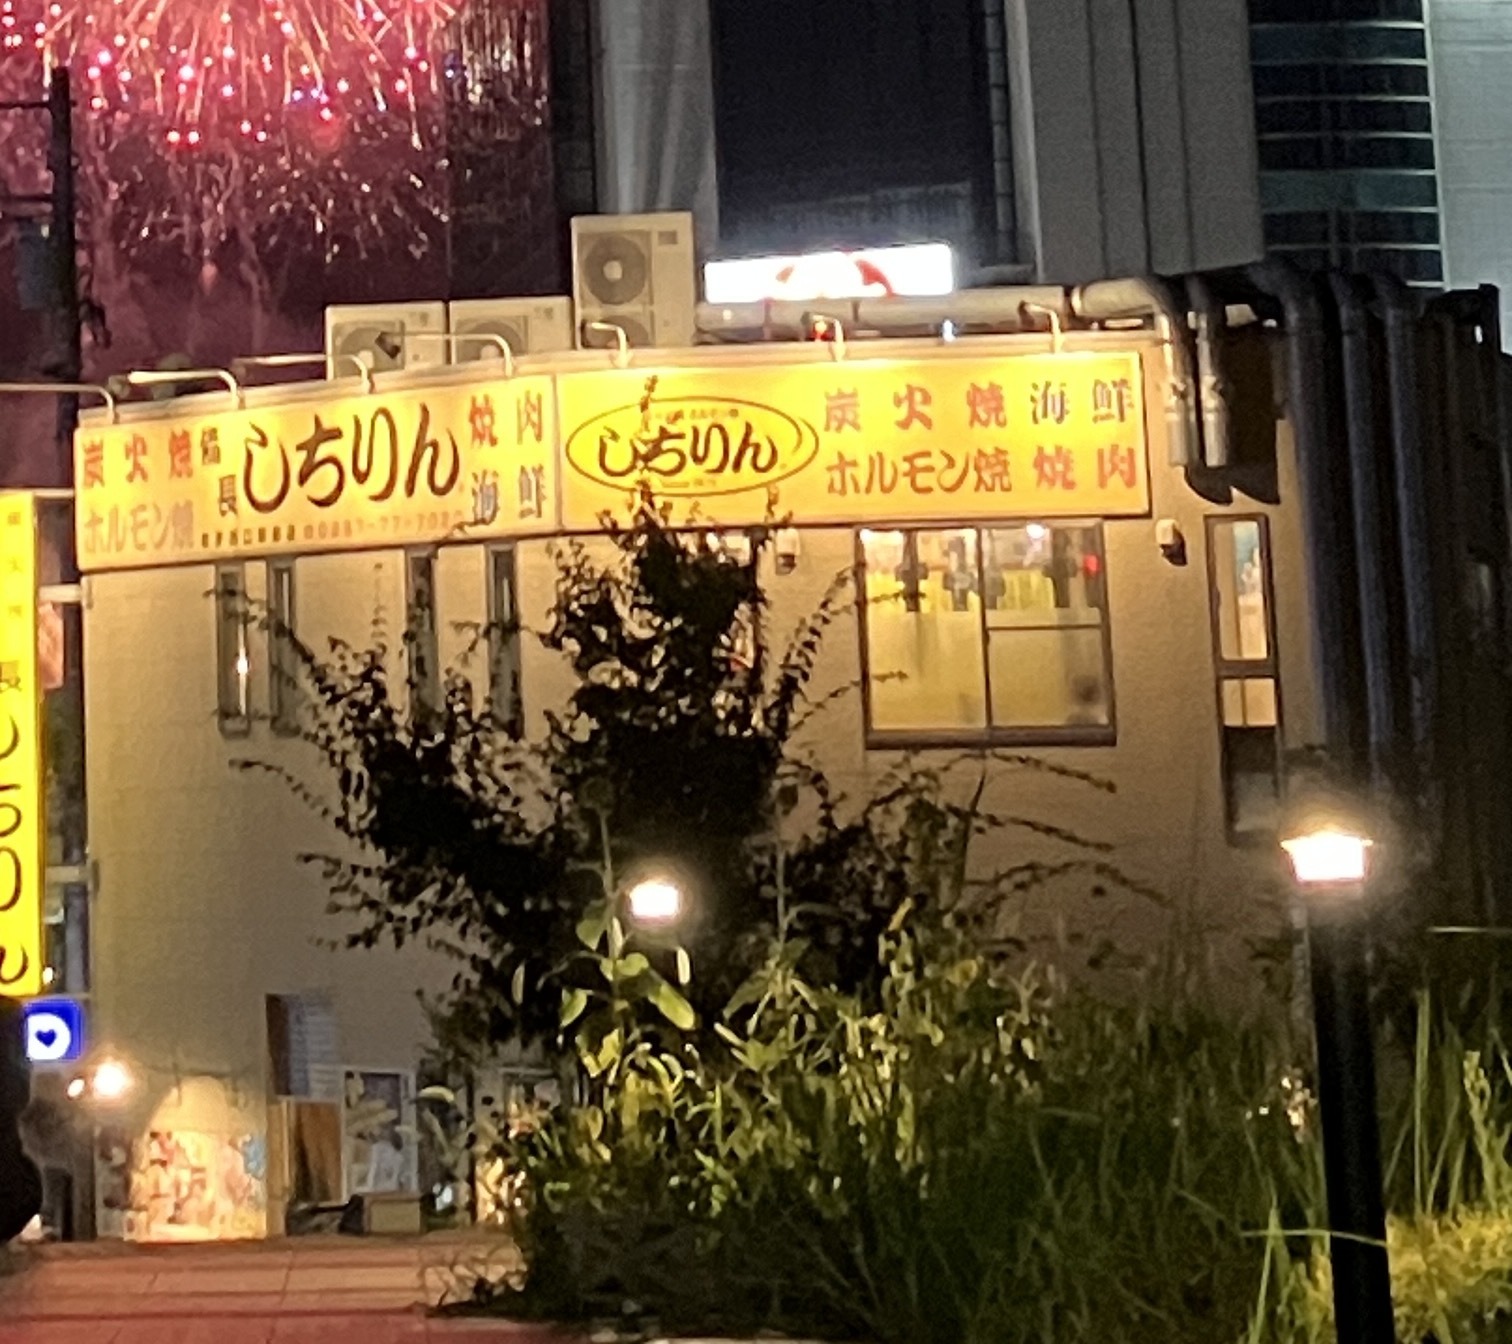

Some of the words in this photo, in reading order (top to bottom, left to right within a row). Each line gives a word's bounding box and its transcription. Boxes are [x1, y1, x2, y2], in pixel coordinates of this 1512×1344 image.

[468, 389, 544, 448] 焼肉
[824, 382, 1008, 434] 炭火焼
[1029, 377, 1136, 426] 海鮮
[82, 428, 195, 489] 炭火焼
[242, 401, 461, 515] しちりん
[598, 420, 779, 478] しちりん
[825, 446, 1013, 497] ホルモン焼
[1032, 443, 1138, 492] 焼肉
[83, 499, 195, 555] ホルモン焼
